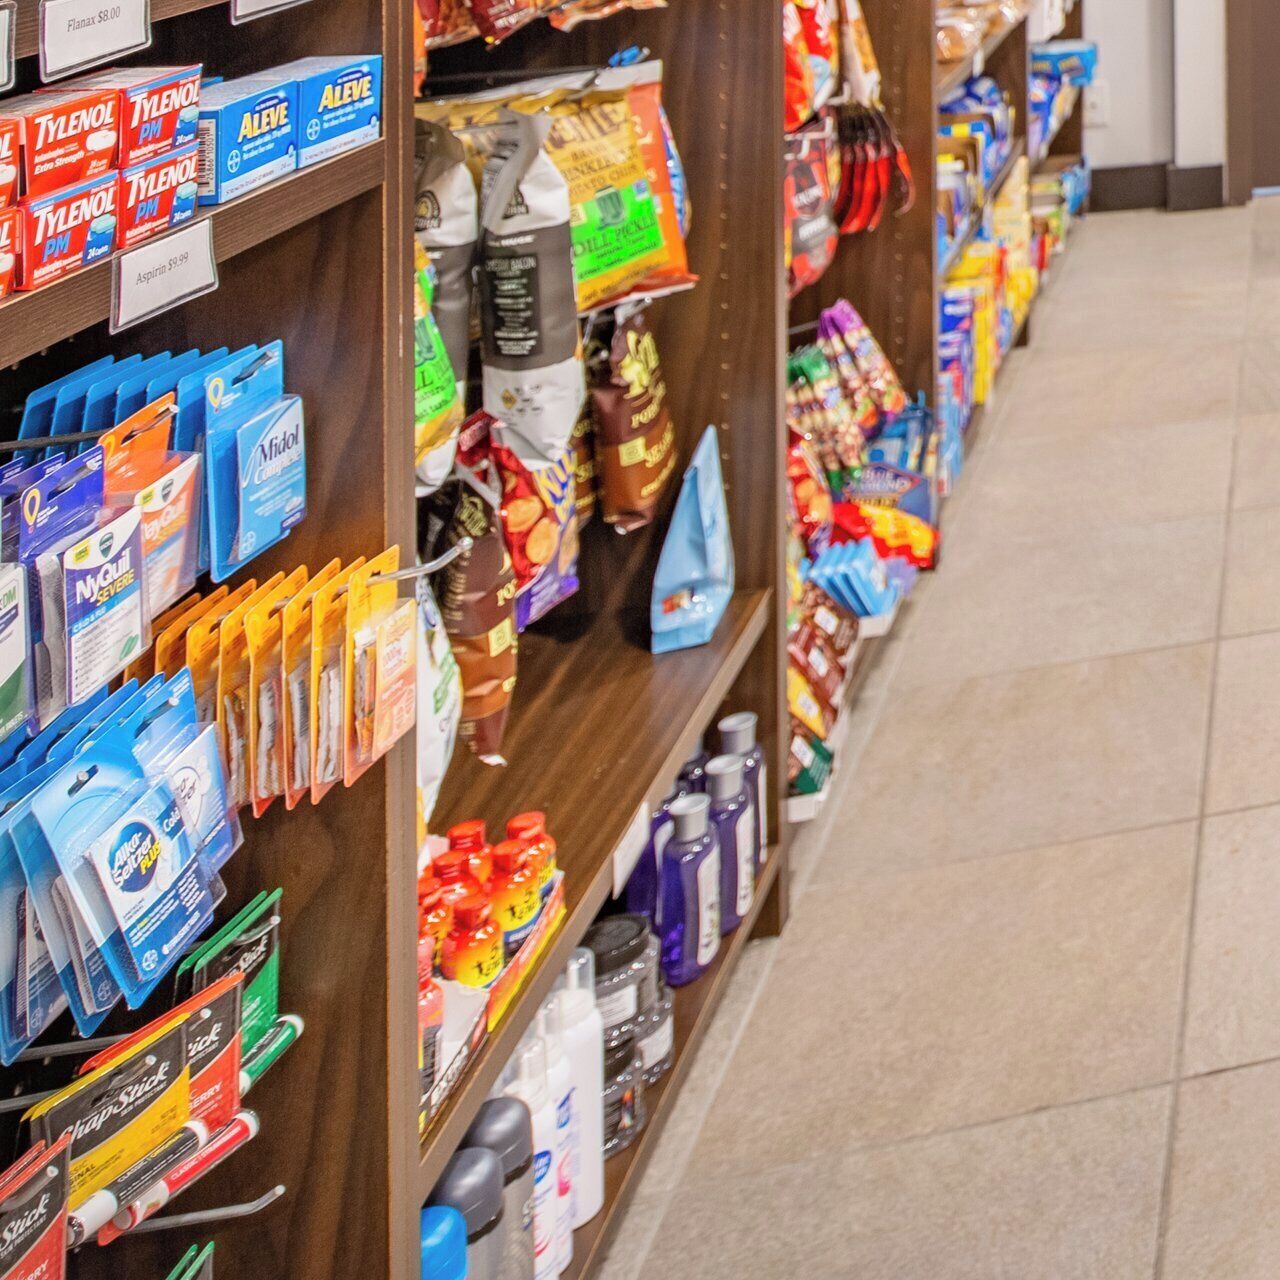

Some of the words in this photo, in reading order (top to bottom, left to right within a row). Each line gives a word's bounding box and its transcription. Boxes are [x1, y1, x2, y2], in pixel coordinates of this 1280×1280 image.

[67, 15, 96, 33] Flanax
[97, 6, 121, 24] $8.00
[128, 80, 201, 130] TYLENOL
[317, 74, 373, 115] ALEVE
[33, 100, 117, 152] TYLENOL
[138, 117, 164, 145] PM
[237, 100, 290, 144] ALEVE
[34, 160, 55, 176] Extra
[54, 150, 86, 169] Strength
[125, 150, 199, 210] TYLENOL
[32, 185, 118, 248] TYLENOL
[134, 194, 160, 225] PM
[41, 230, 72, 264] PM
[135, 264, 167, 287] Aspirin
[167, 250, 191, 271] $9.99
[257, 428, 301, 469] Midol
[75, 547, 133, 606] NyQuil
[95, 566, 136, 607] SEVERE
[162, 807, 182, 834] Cold
[111, 834, 154, 889] Seltzer
[113, 830, 144, 868] Alka-
[140, 838, 162, 877] PLUS
